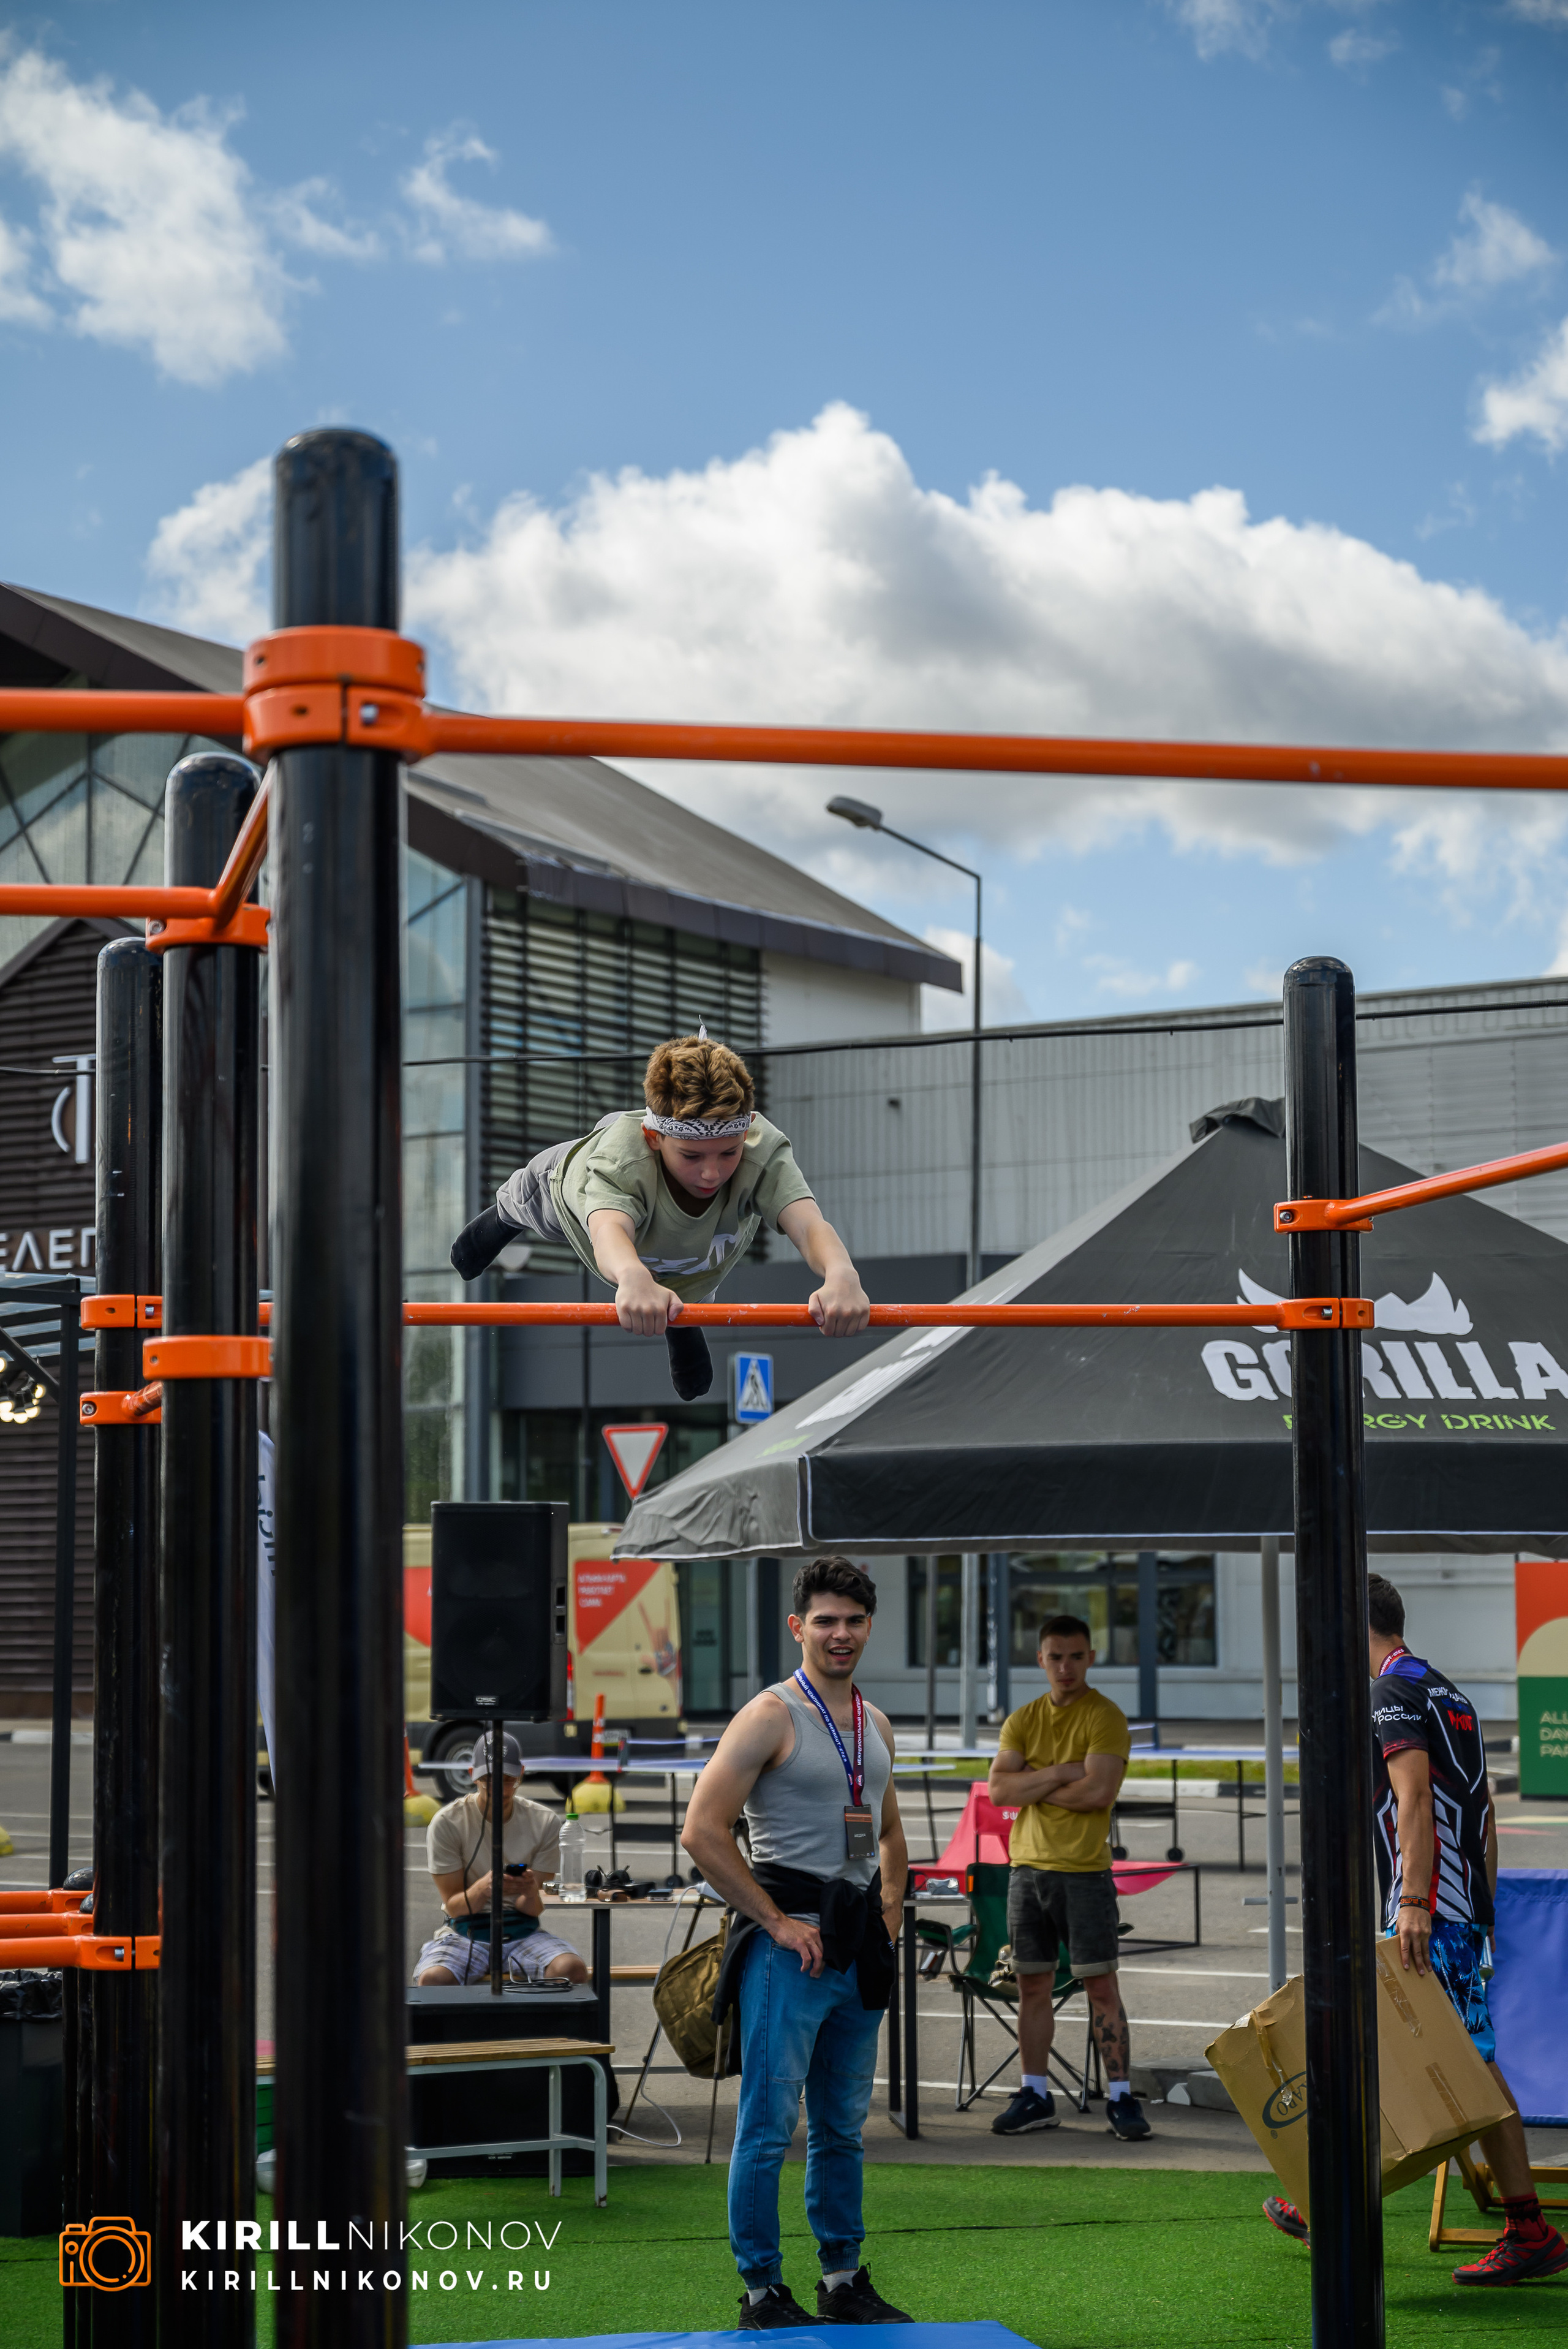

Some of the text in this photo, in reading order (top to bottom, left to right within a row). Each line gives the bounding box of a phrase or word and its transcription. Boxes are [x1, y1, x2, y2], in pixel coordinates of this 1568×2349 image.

[1441, 1414, 1556, 1431] DRINK
[807, 1689, 826, 1714] ЧЕМПИОНАТ
[1372, 1706, 1403, 1722] УЛИЦЫ
[1378, 1713, 1421, 1725] РОССИИ
